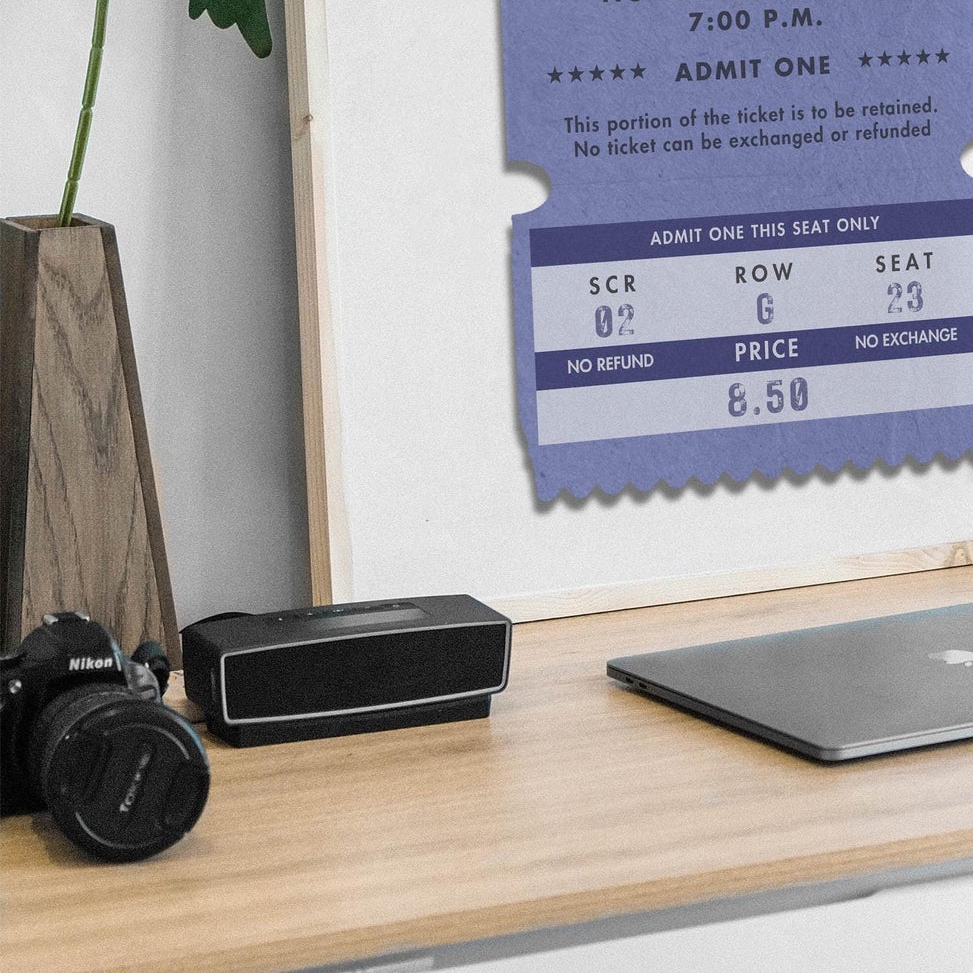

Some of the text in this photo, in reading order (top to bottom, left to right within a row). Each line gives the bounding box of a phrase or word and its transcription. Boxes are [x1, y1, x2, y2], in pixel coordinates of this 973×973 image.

[688, 7, 823, 32] 7:00 P.M.
[674, 55, 831, 83] ADMIT ONE
[563, 95, 938, 137] This portion of the ticket is to be retained.
[574, 118, 931, 158] No ticket can be exchanged or refunded
[650, 215, 880, 246] ADMIT ONE THIS SEAT ONLY
[735, 262, 793, 284] ROW
[875, 251, 933, 274] SEAT
[589, 274, 636, 296] SCR
[886, 280, 924, 314] 23
[594, 303, 635, 338] 02
[756, 292, 774, 325] G
[735, 337, 799, 362] PRICE
[855, 327, 958, 350] NO EXCHANGE
[567, 353, 655, 374] NO REFUND
[727, 376, 809, 418] 8.50
[68, 657, 113, 671] Nikon
